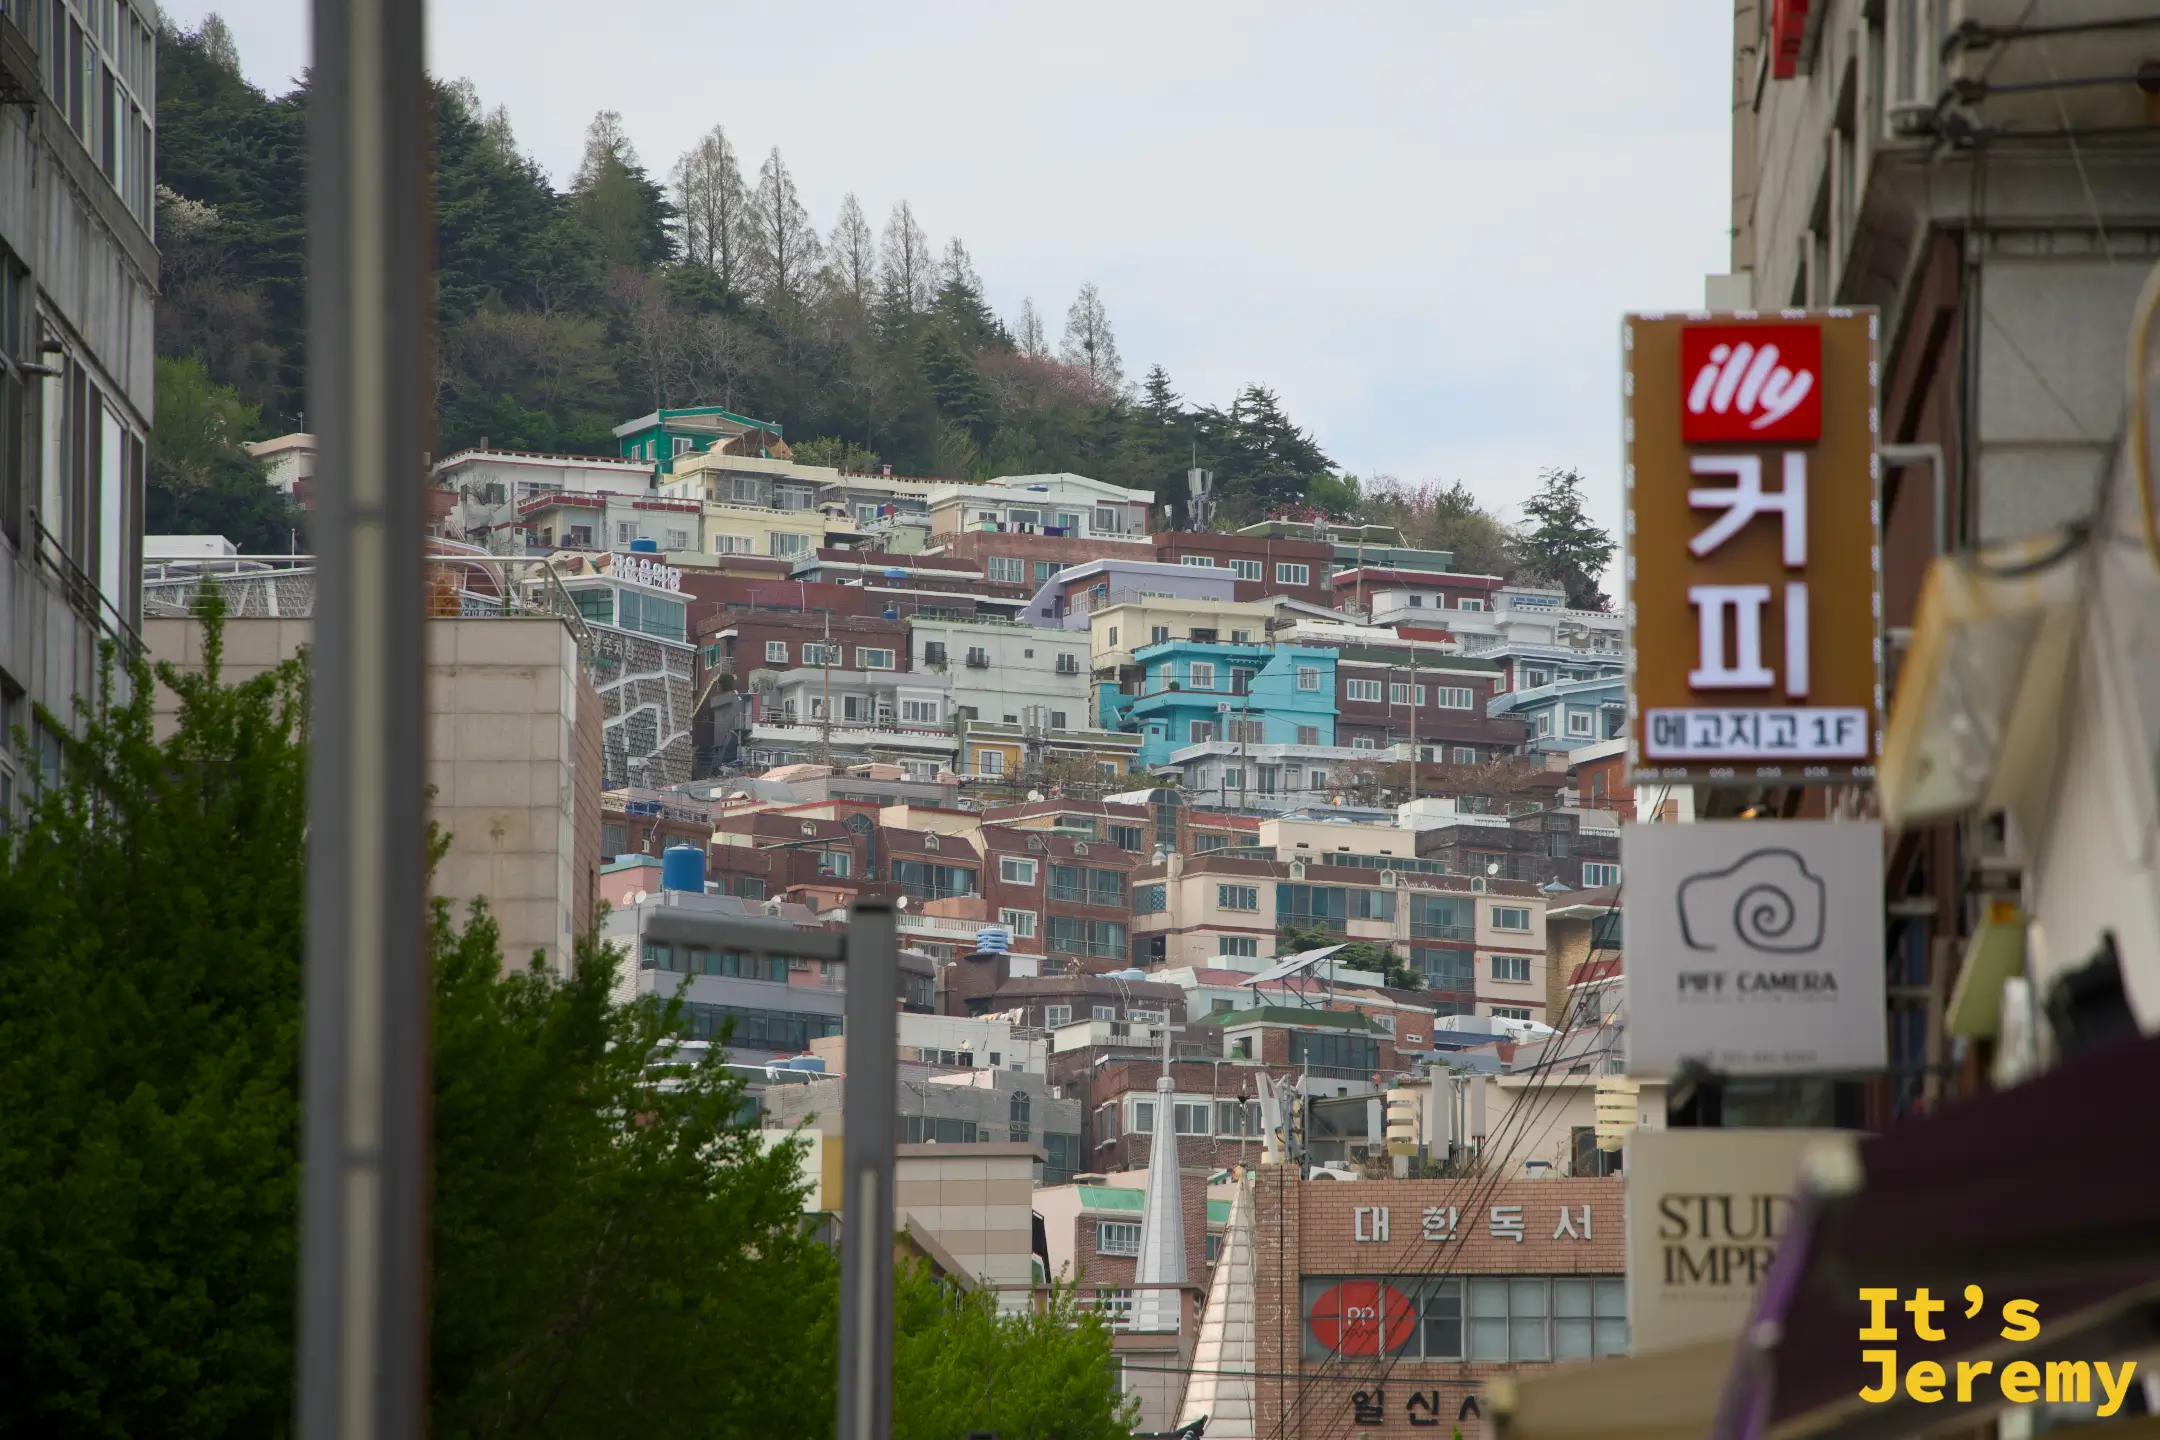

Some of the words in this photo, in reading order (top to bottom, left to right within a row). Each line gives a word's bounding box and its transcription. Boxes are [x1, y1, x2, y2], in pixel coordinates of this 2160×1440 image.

[1688, 342, 1814, 430] illy
[1688, 451, 1809, 697] 커피
[1811, 716, 1857, 747] 1F
[1736, 970, 1839, 992] CAMERA
